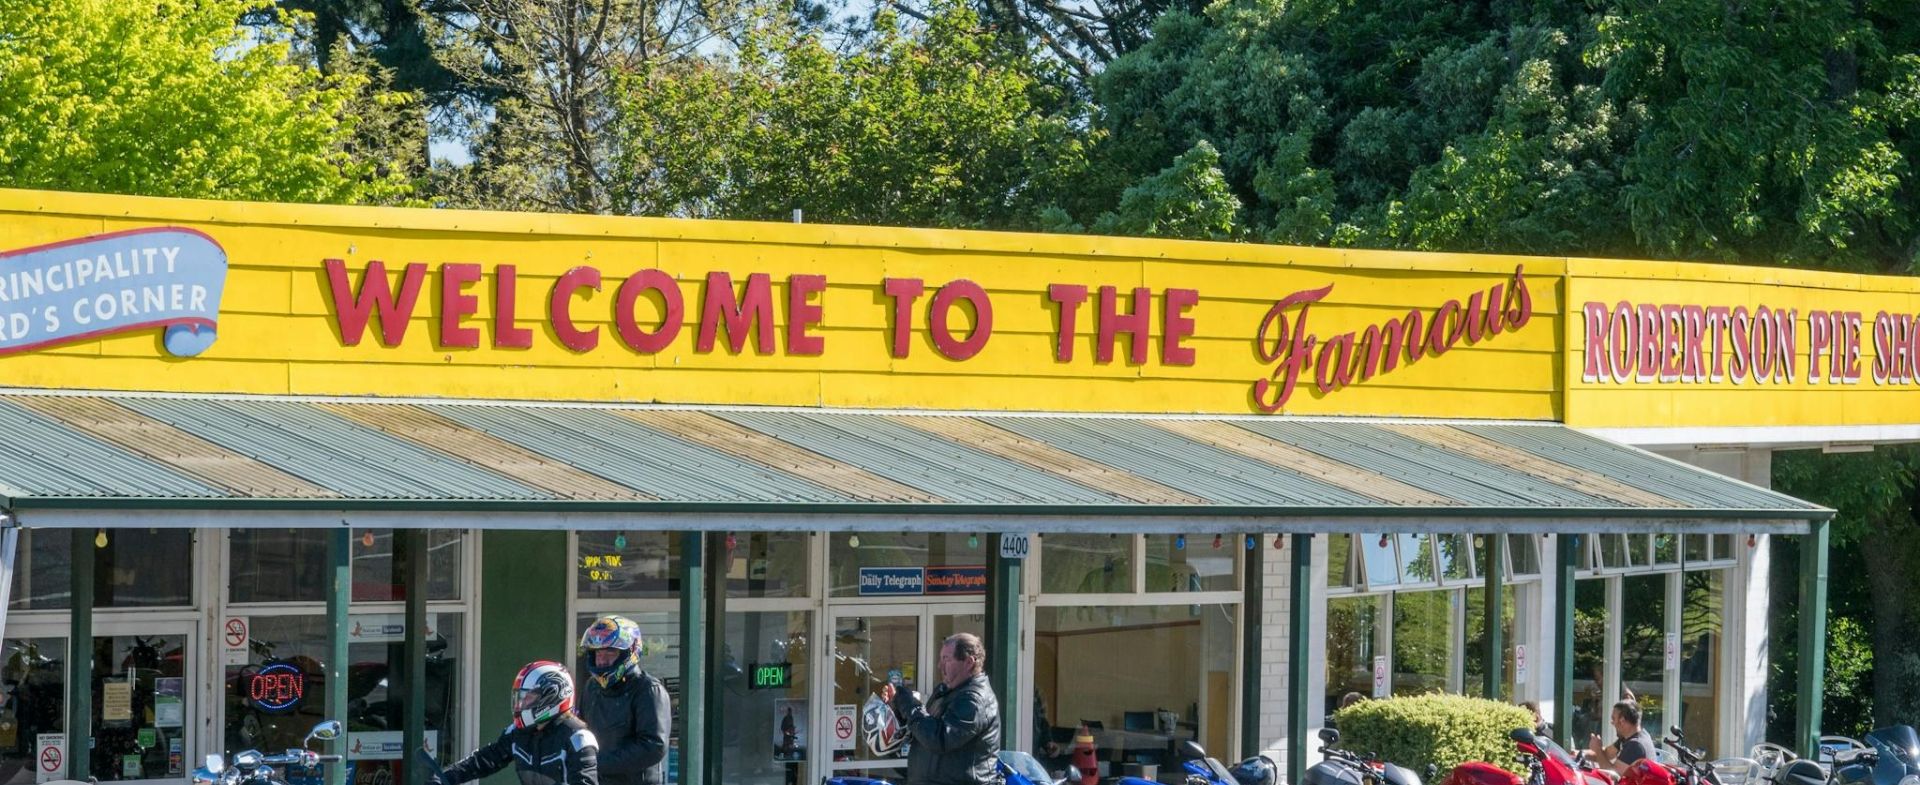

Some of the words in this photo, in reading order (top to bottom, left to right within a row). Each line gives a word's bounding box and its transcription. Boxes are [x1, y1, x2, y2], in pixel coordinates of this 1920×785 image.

[73, 284, 207, 325] CORNER
[323, 259, 826, 356] WELCOME
[885, 278, 992, 361] TO
[1049, 284, 1198, 366] THE
[1255, 263, 1533, 413] Famous
[1583, 301, 1798, 385] ROBERTSON
[1808, 311, 1862, 385] PIE
[1003, 537, 1028, 554] 4400
[861, 575, 882, 588] Daily
[883, 575, 922, 588] Telegraph
[926, 575, 954, 587] Sunday
[252, 674, 303, 700] OPEN
[757, 667, 783, 685] OPEN
